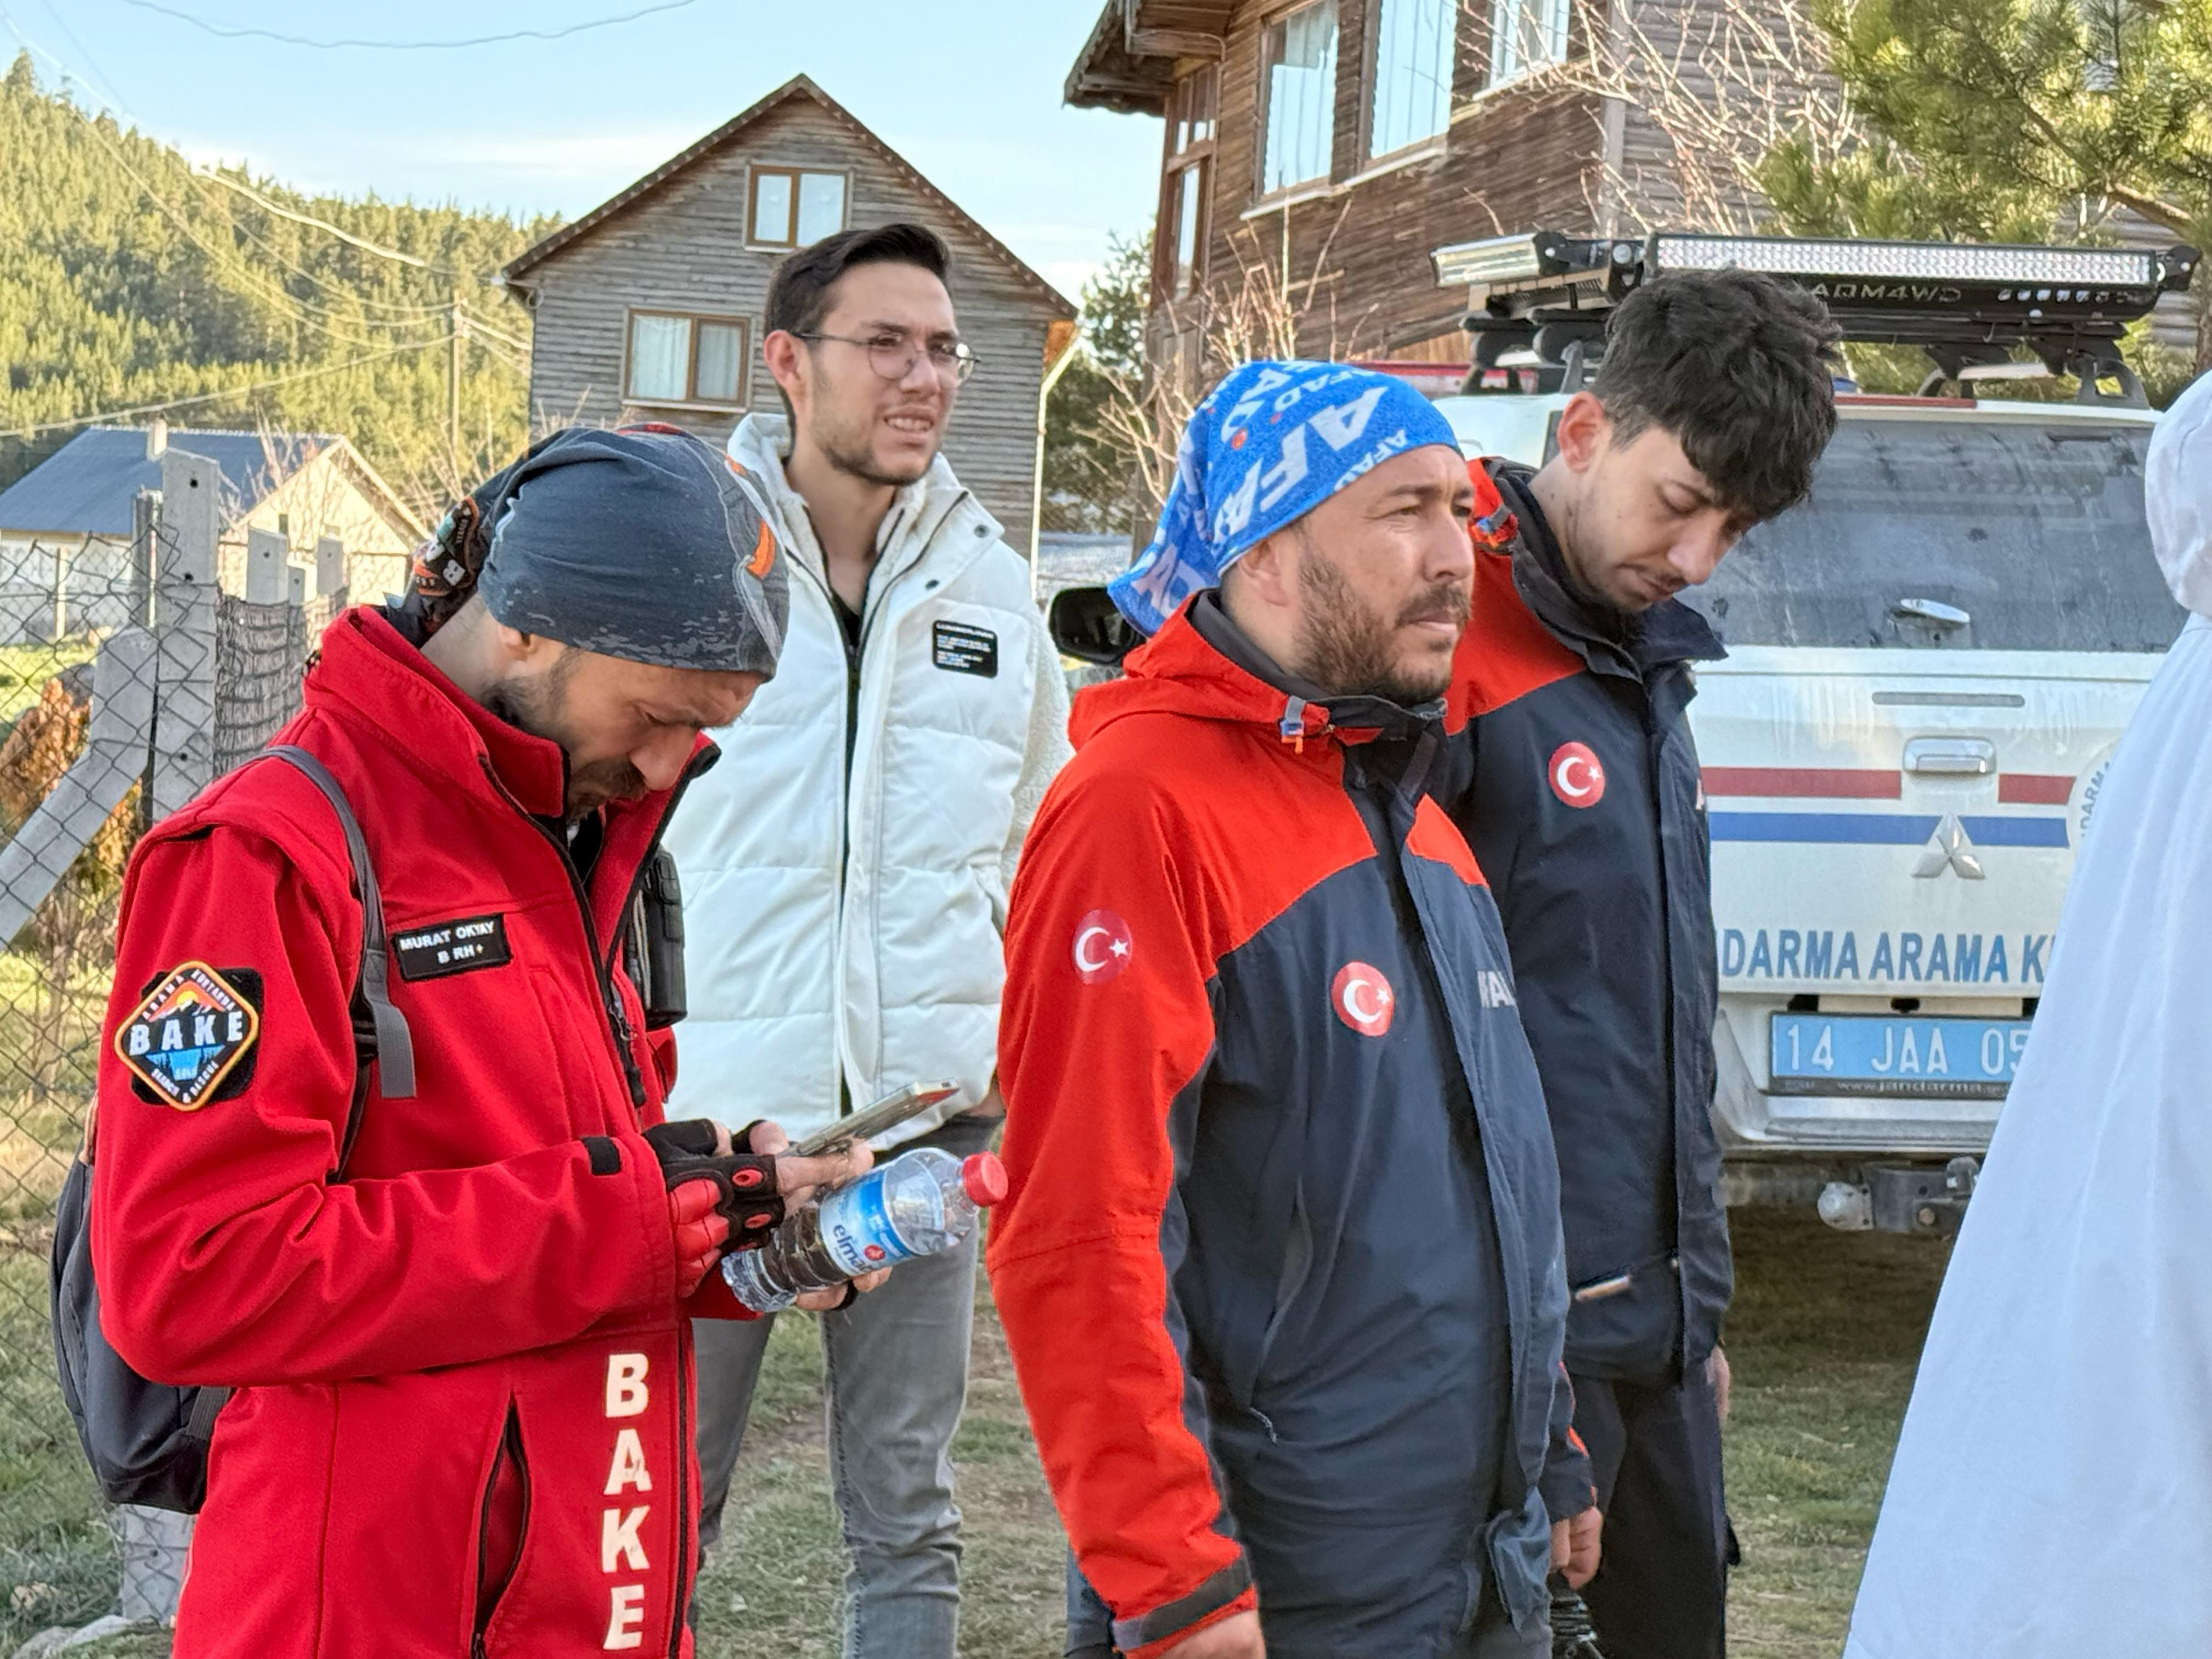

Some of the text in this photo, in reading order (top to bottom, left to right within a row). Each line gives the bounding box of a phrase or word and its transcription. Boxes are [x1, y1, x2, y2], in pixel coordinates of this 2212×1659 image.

[399, 921, 495, 951] MURAT OKYAY
[437, 950, 450, 964] B
[1721, 928, 2057, 984] DARMA ARAMA K
[129, 1011, 243, 1057] BAKE
[1787, 1024, 1835, 1072] 14
[1870, 1026, 1949, 1075] JAA
[602, 1352, 652, 1652] BAKE
